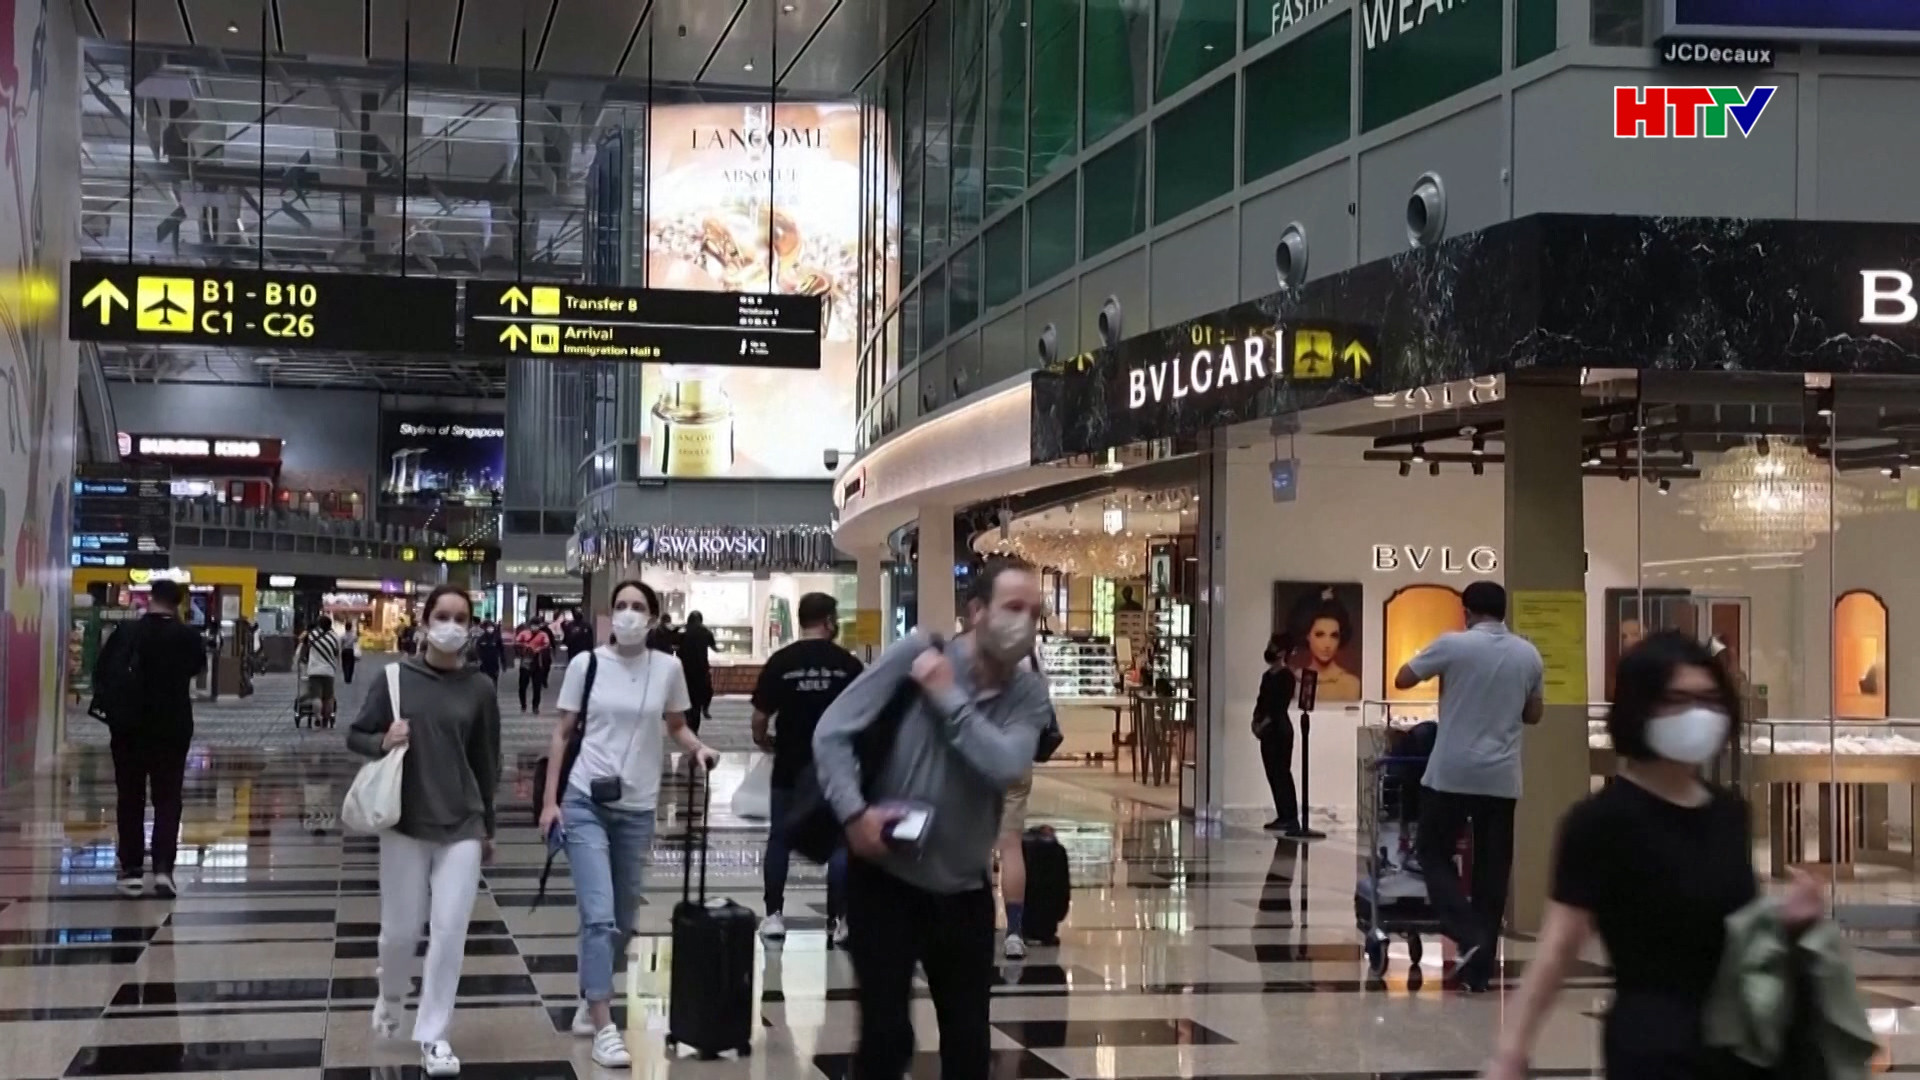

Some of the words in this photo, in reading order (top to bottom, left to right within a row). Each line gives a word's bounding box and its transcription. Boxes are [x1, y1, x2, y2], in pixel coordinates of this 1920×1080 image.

[1363, 0, 1466, 49] WE
[1664, 43, 1771, 63] JCDecaux
[203, 280, 234, 303] B1
[265, 282, 317, 307] B10
[565, 295, 624, 311] Transfer
[628, 298, 638, 312] B
[1859, 269, 1918, 323] B
[201, 310, 233, 334] C1
[263, 312, 315, 338] C26
[564, 326, 613, 340] Arrival
[563, 344, 628, 357] Immigration
[630, 346, 651, 357] Hall
[1129, 330, 1284, 410] BVLGARI
[400, 423, 436, 437] Skyline
[438, 425, 450, 435] of
[451, 424, 504, 439] Singapore
[659, 535, 766, 554] SWAROVSKI
